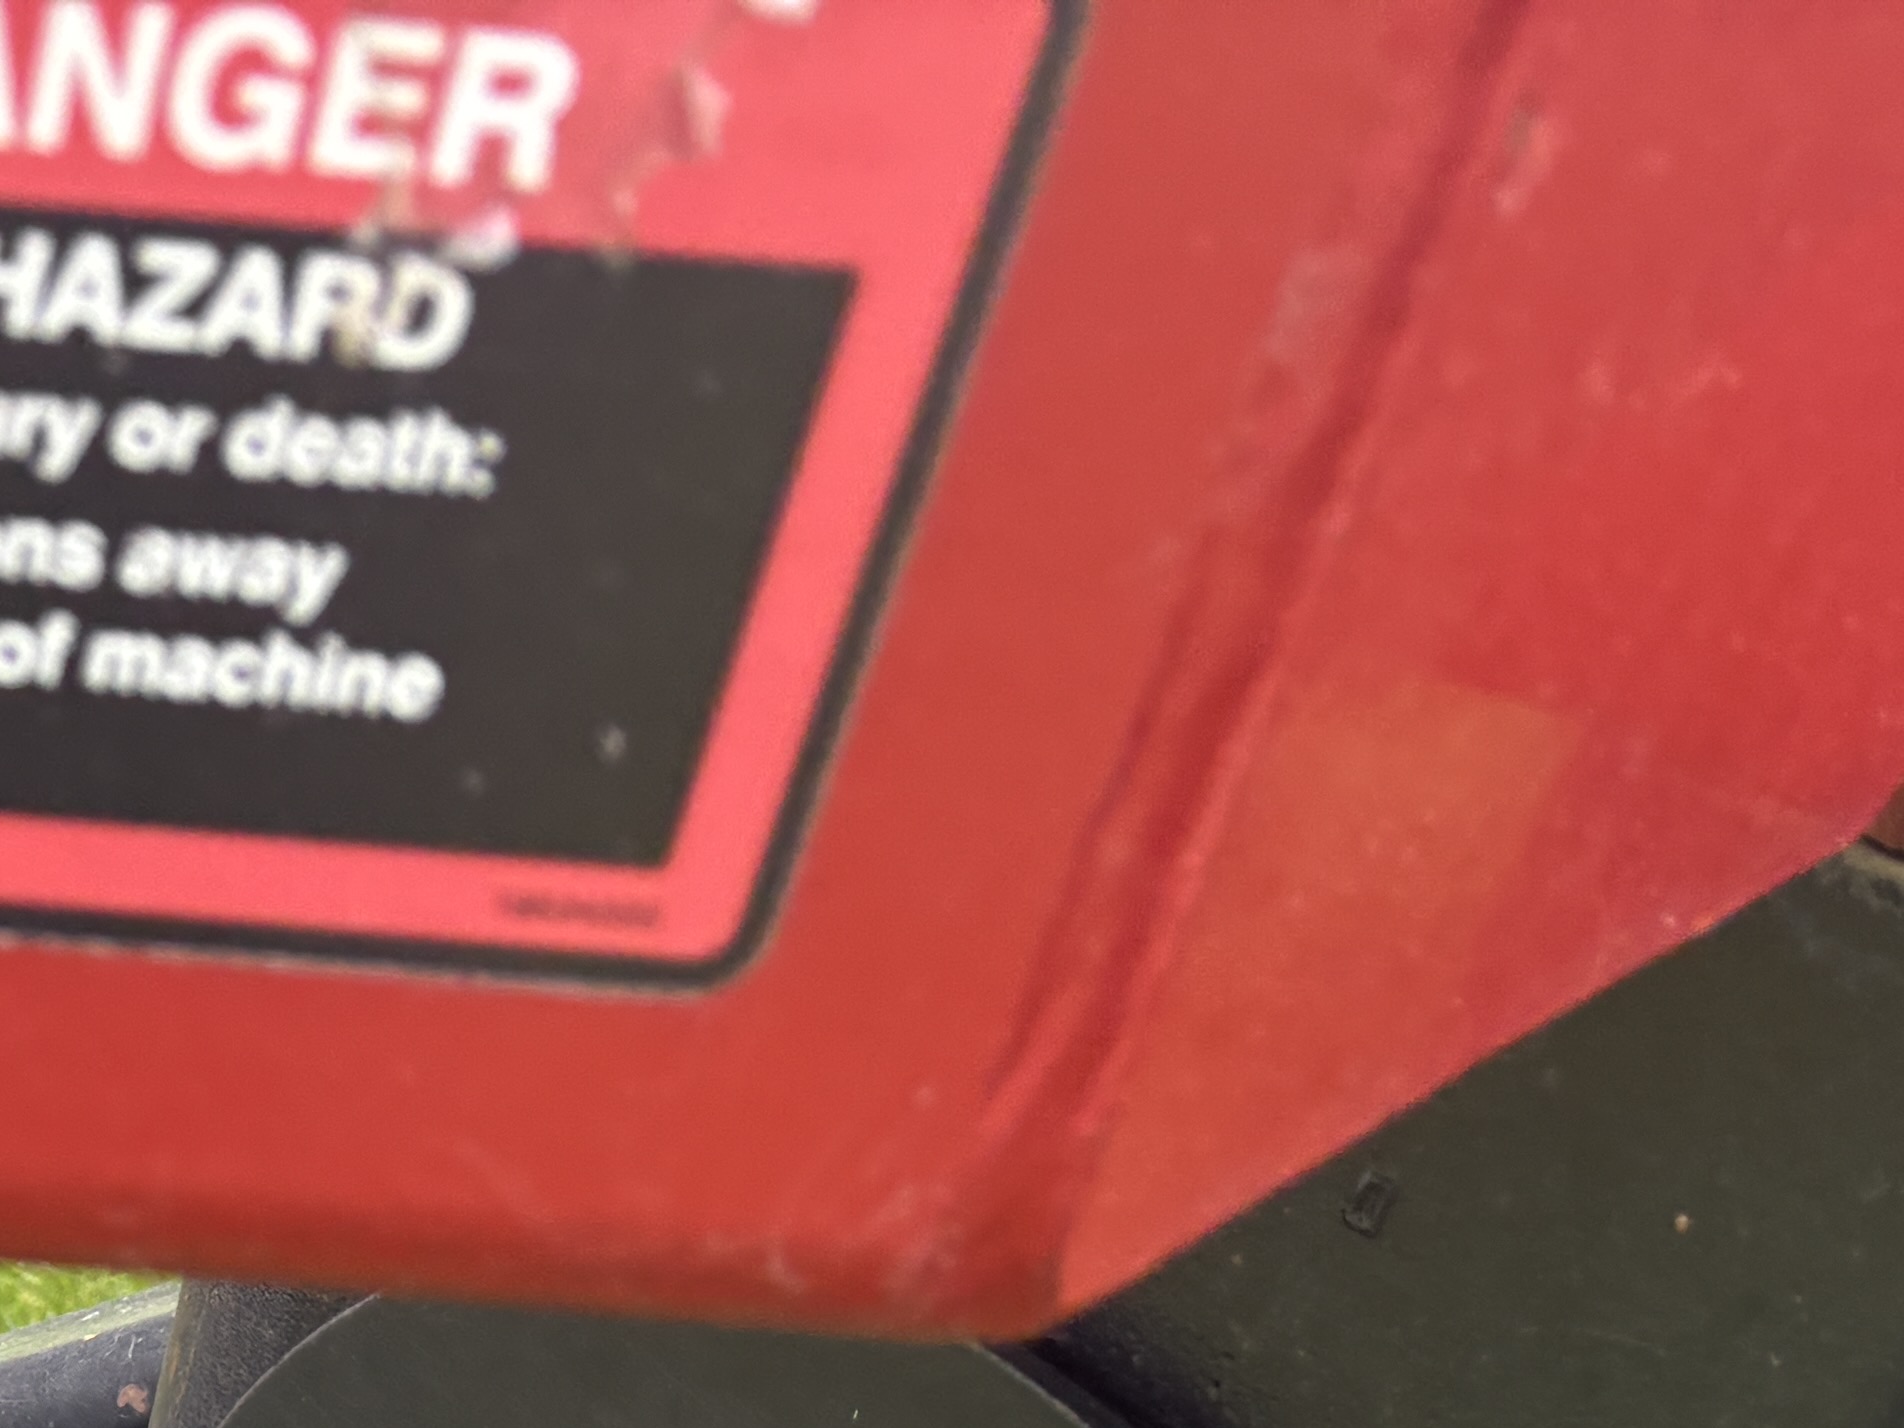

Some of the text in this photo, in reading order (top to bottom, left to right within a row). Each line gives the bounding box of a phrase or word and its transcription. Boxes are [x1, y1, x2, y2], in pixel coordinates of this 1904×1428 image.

[111, 402, 213, 469] or
[225, 400, 500, 493] death:
[120, 530, 345, 622] away
[84, 632, 442, 718] machine
